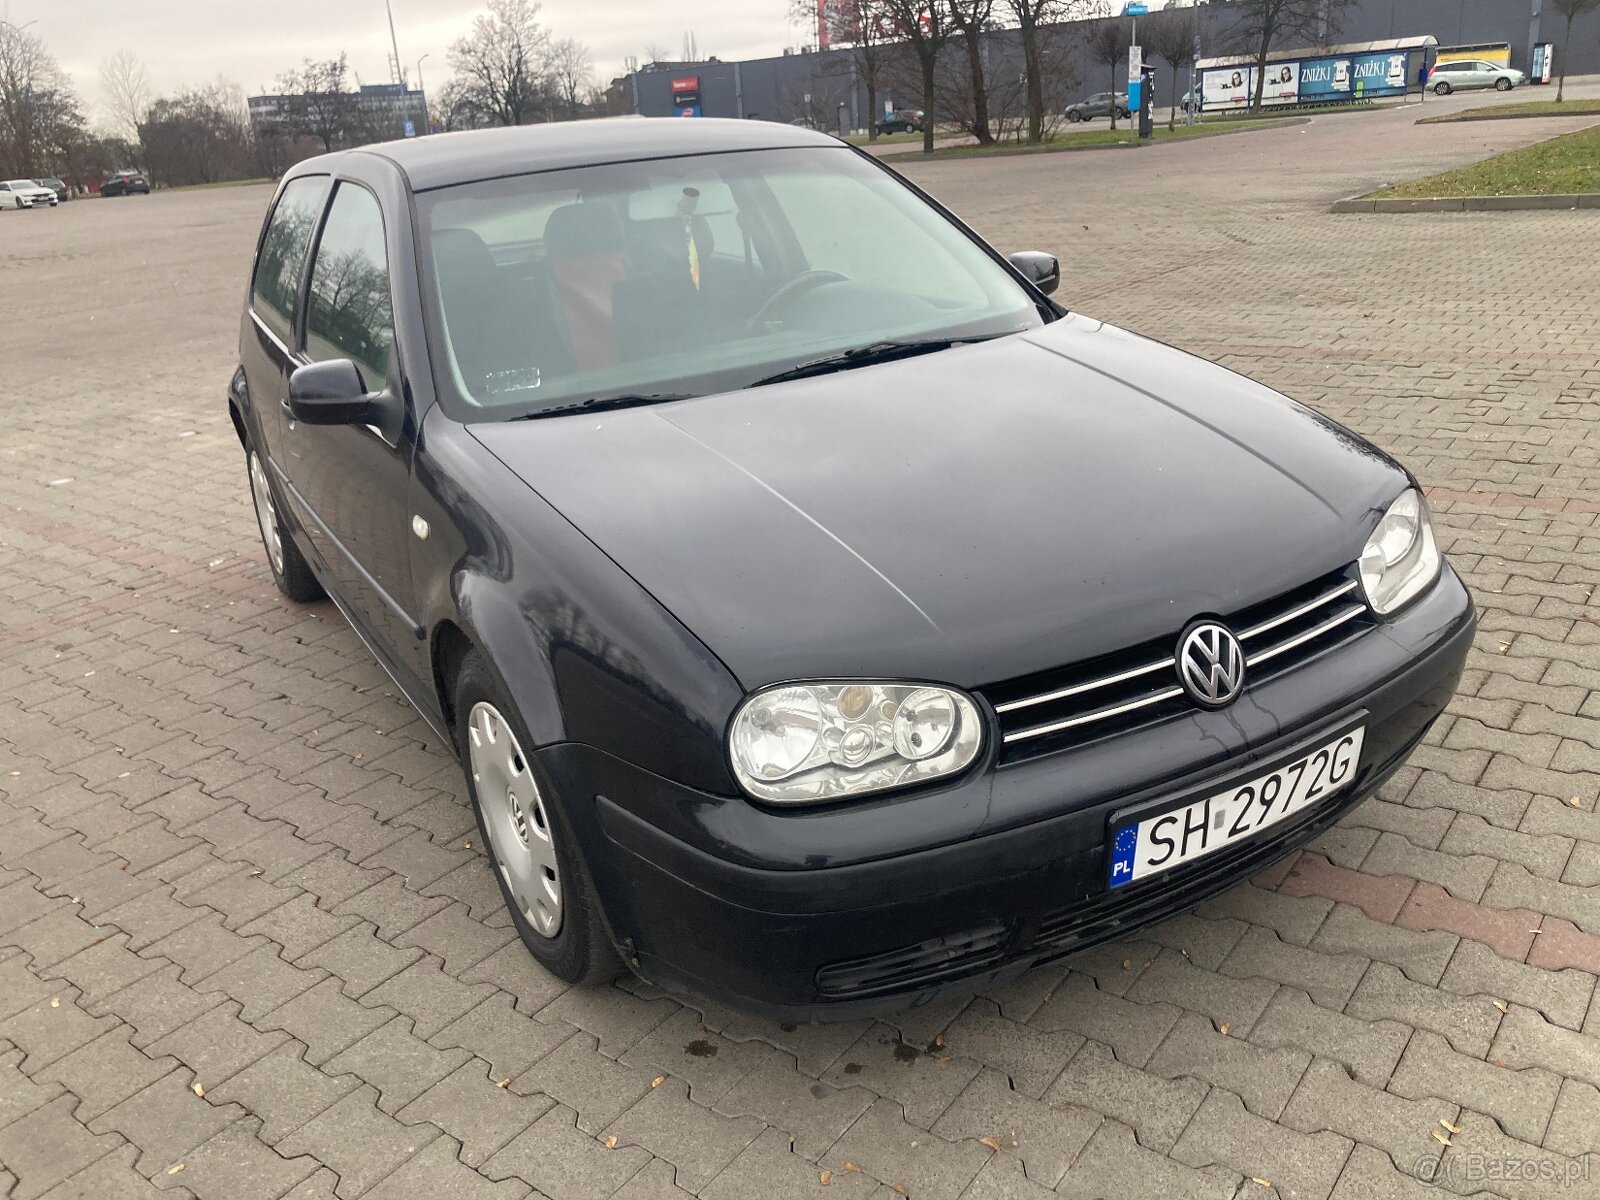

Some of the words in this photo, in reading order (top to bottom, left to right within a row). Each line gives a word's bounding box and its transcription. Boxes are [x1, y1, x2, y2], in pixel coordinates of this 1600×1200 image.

[1147, 799, 1210, 866] SH
[1227, 736, 1354, 838] 2972G
[1113, 860, 1131, 877] PL
